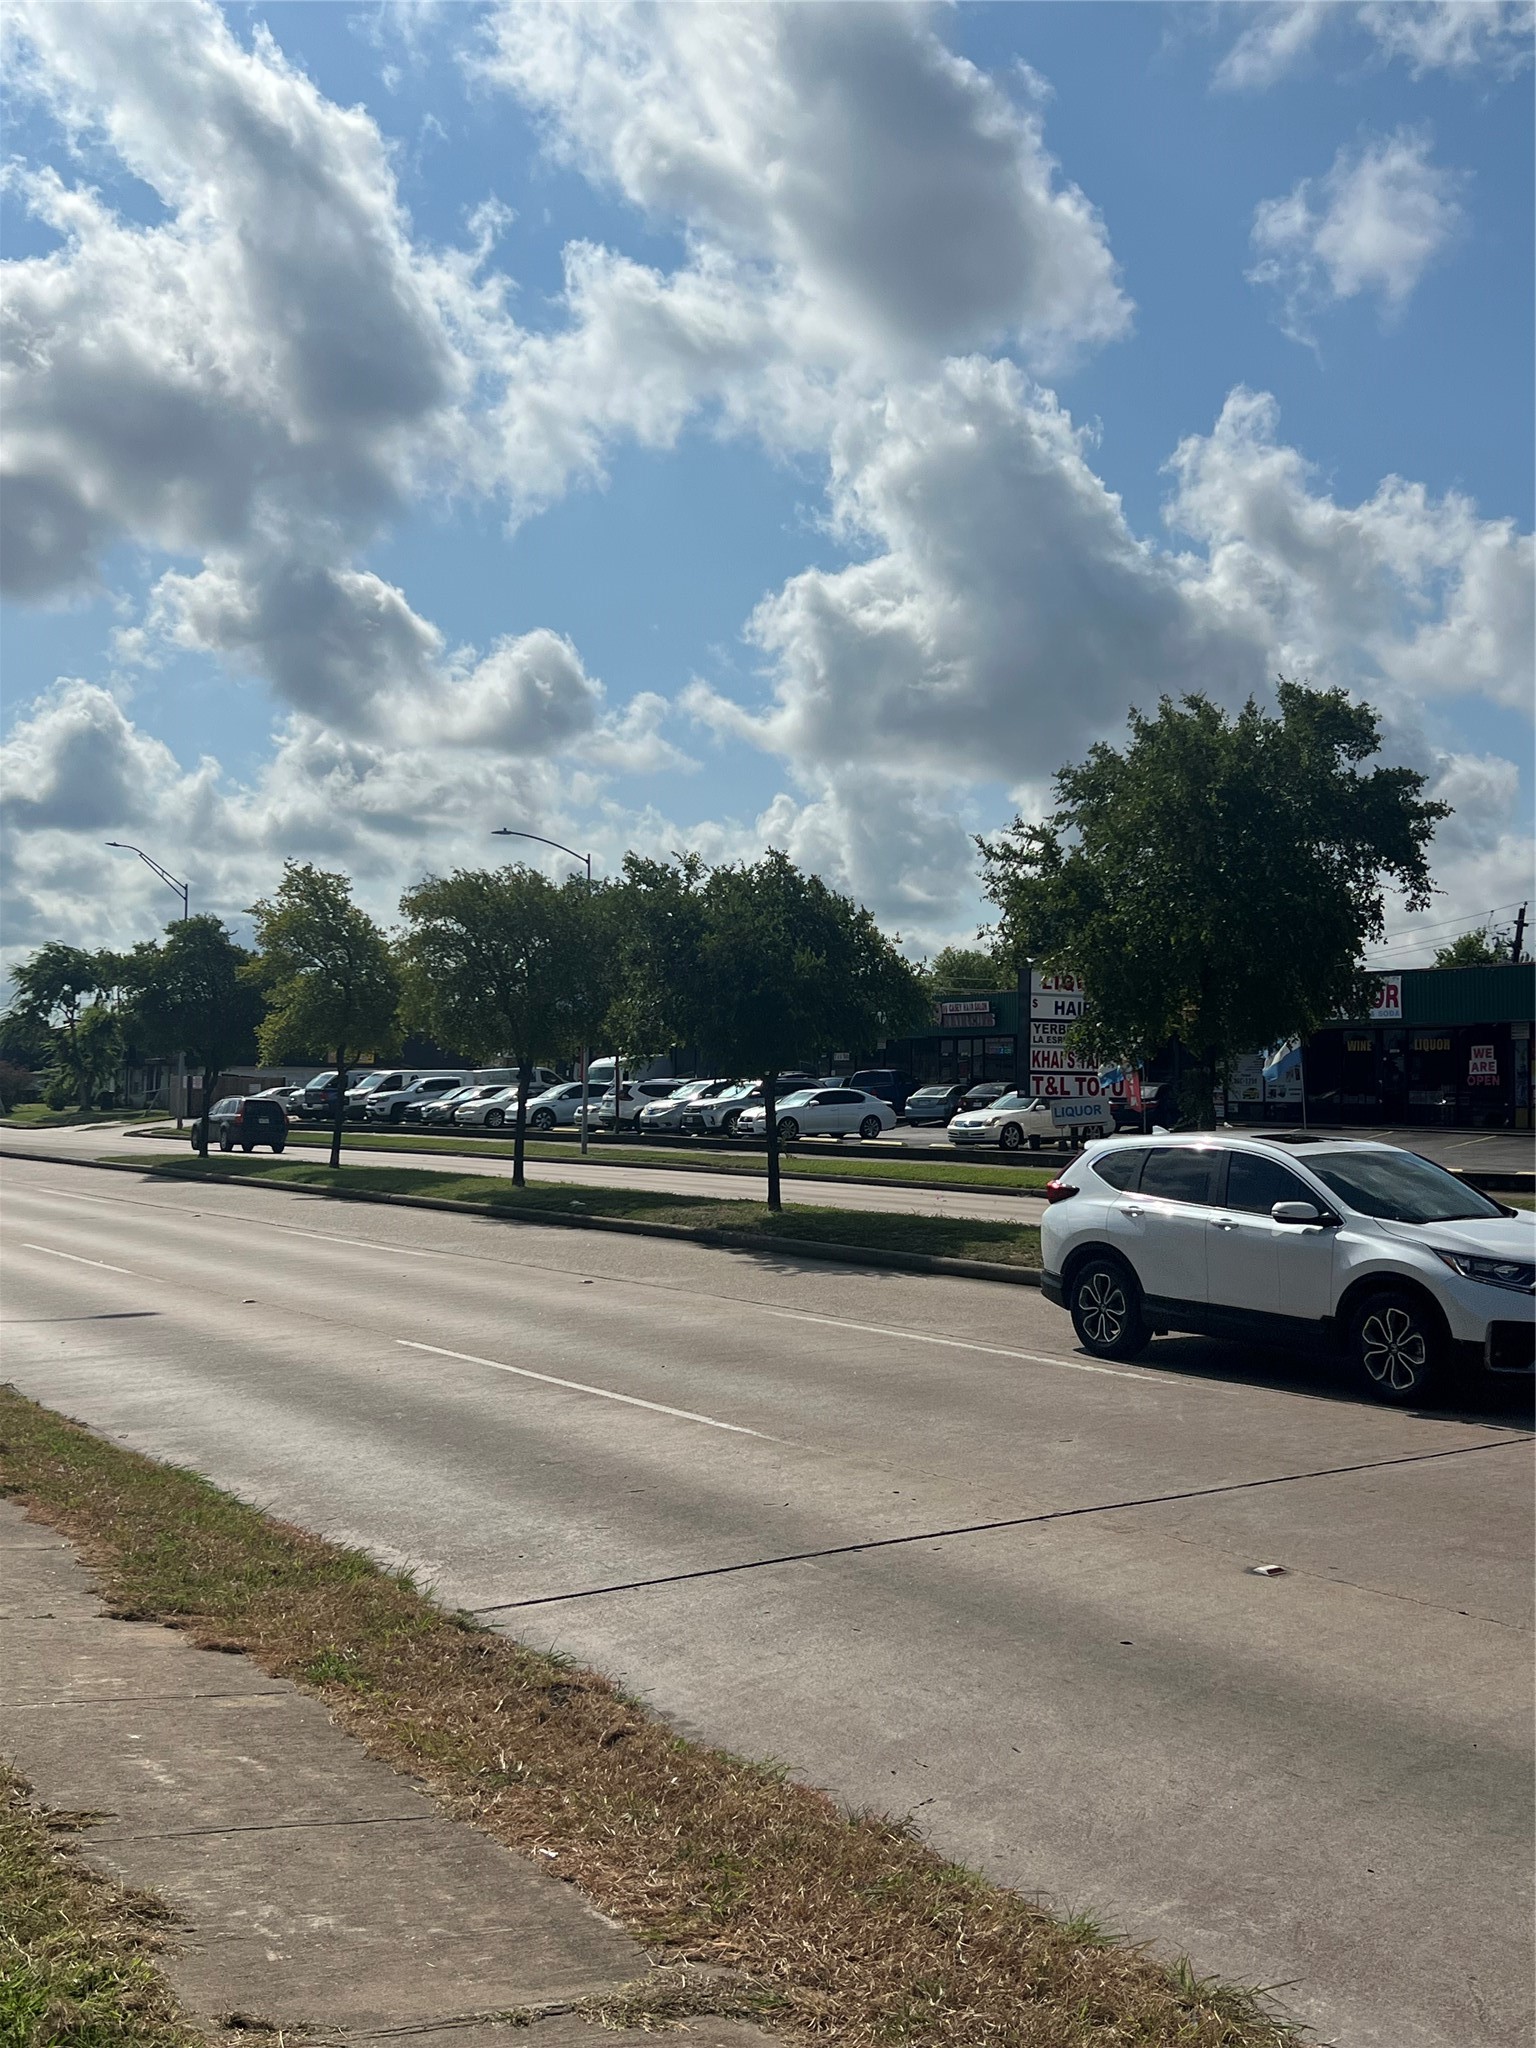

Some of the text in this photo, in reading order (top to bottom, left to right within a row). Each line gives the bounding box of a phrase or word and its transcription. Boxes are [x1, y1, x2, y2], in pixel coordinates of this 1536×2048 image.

[1033, 1023, 1068, 1035] YERB
[1033, 1036, 1044, 1044] LA
[1347, 1040, 1373, 1052] WINE
[1414, 1039, 1451, 1052] LIQUOR
[1473, 1048, 1493, 1058] WE
[1471, 1061, 1496, 1072] ARE
[1032, 1076, 1071, 1096] T&L
[1467, 1075, 1500, 1085] OPEN
[1054, 1104, 1102, 1119] LIQUOR
